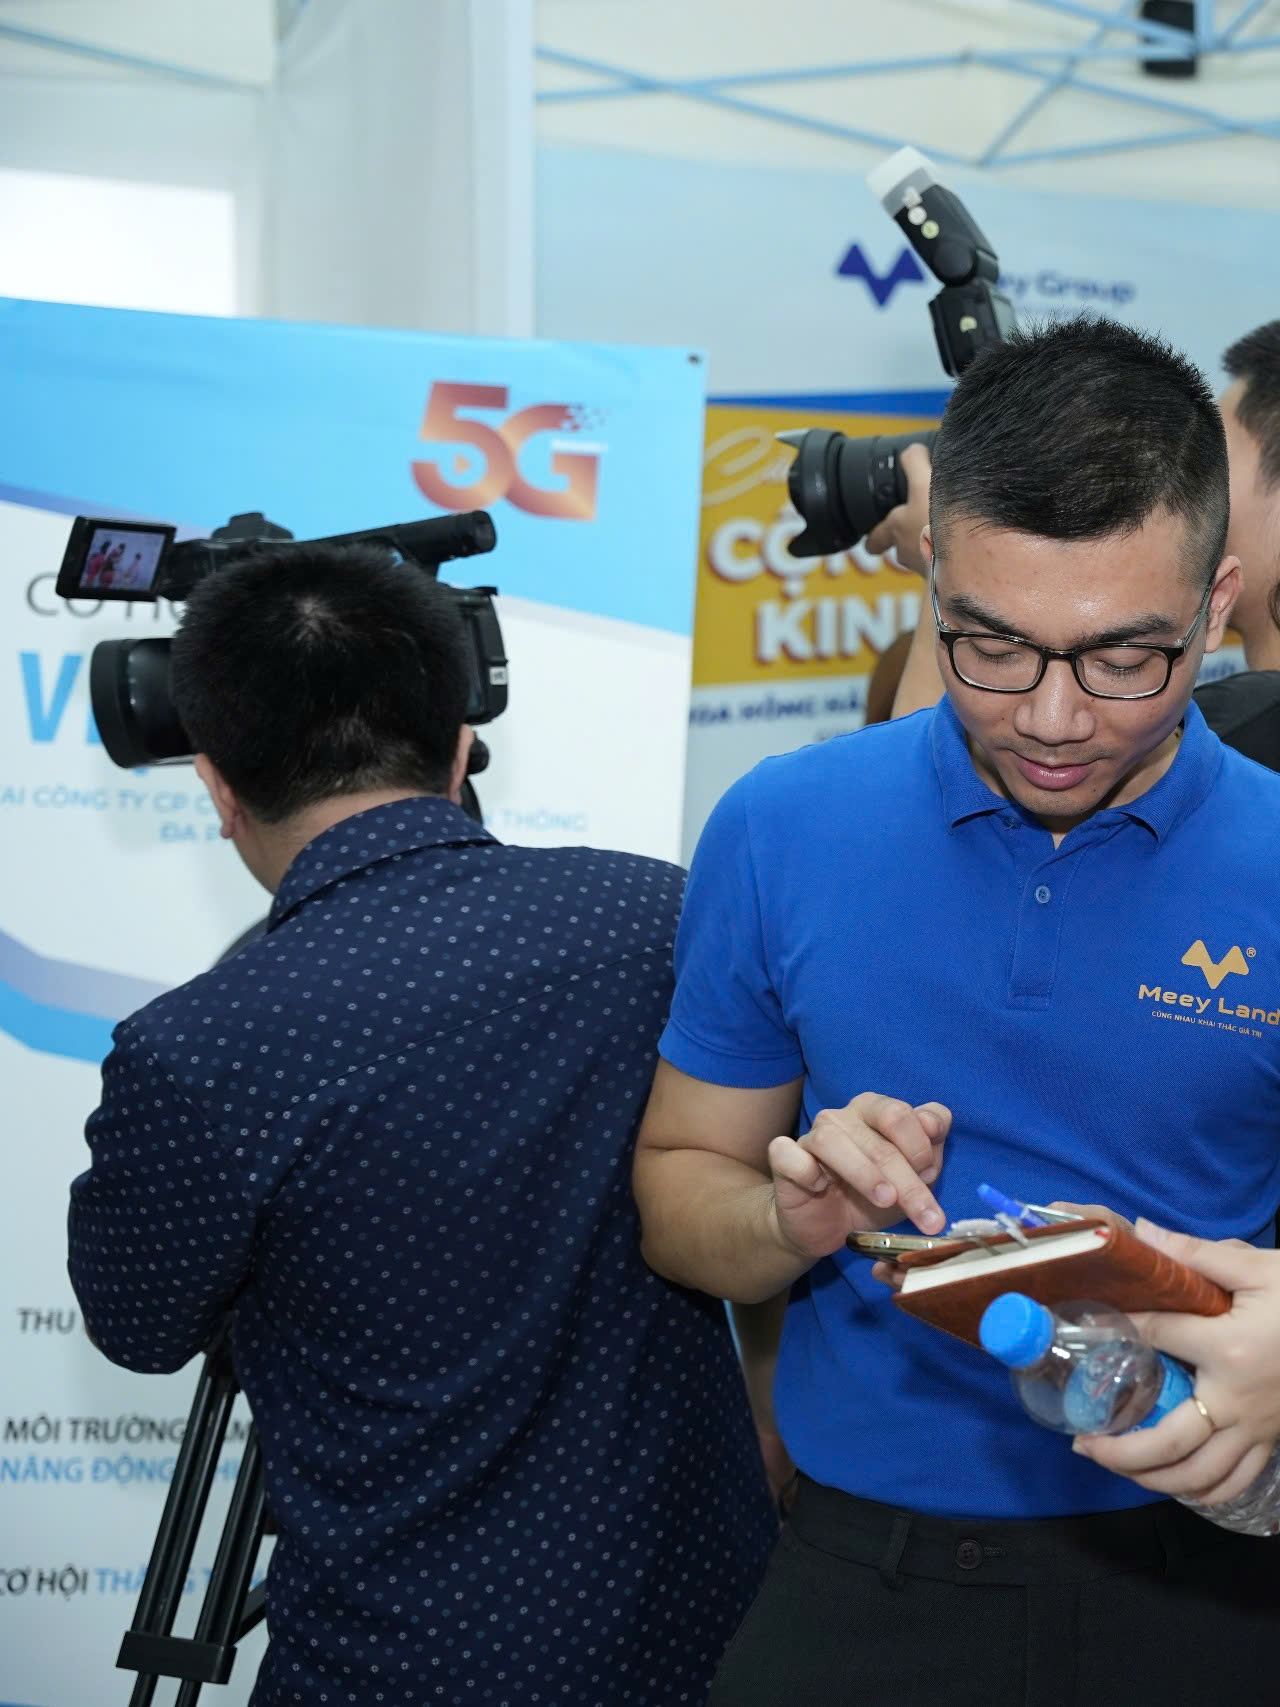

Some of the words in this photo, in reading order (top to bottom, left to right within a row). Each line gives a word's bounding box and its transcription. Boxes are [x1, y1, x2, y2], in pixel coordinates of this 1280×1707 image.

[410, 380, 605, 521] 5G
[1138, 984, 1212, 1014] Meey
[1217, 997, 1280, 1025] Land
[1152, 1010, 1173, 1020] CÙNG
[1174, 1015, 1196, 1024] NHAU
[1198, 1018, 1216, 1027] KHAI
[1218, 1021, 1237, 1032] THÁC
[17, 1308, 76, 1335] THU
[4, 1412, 61, 1443] MÔI
[67, 1413, 186, 1444] TRƯỜNG
[36, 1564, 88, 1601] HỘI
